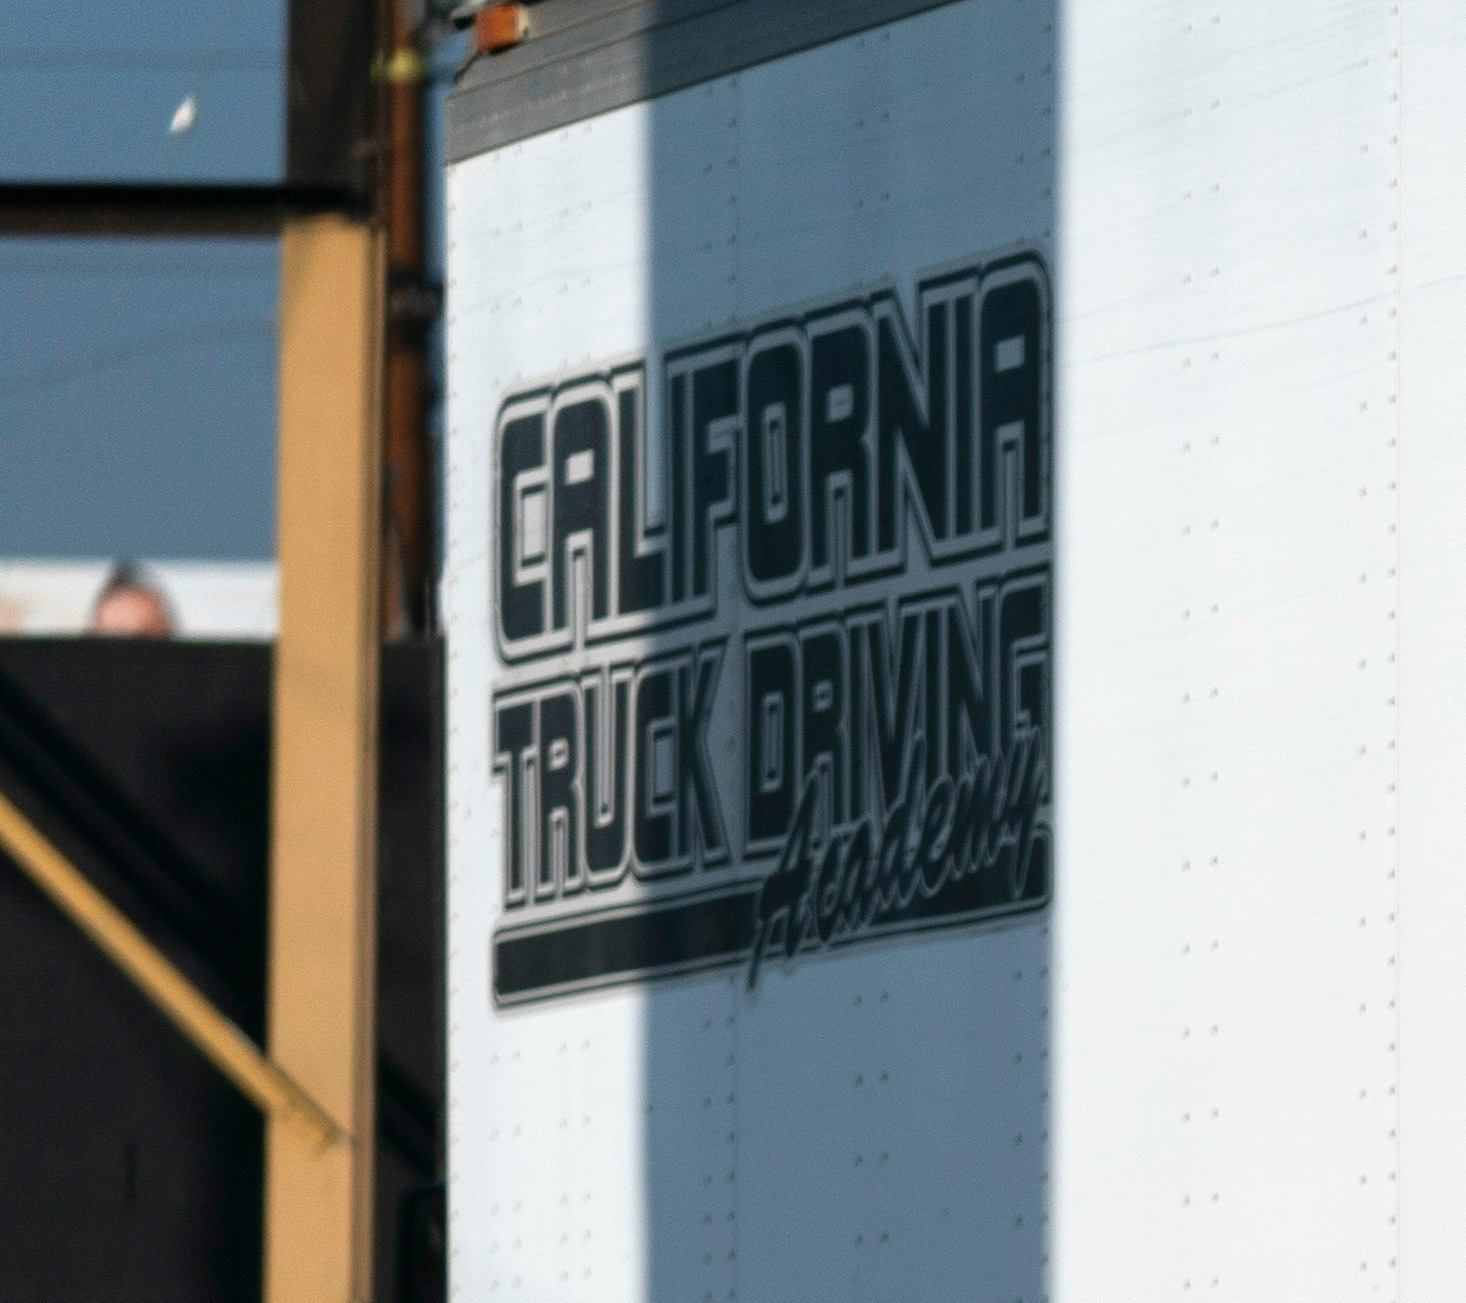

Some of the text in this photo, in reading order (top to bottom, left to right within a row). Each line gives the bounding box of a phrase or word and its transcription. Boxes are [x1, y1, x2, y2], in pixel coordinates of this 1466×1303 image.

[494, 248, 1055, 666] CALIFORNIA
[491, 562, 1055, 912] TRUCK DRIVING
